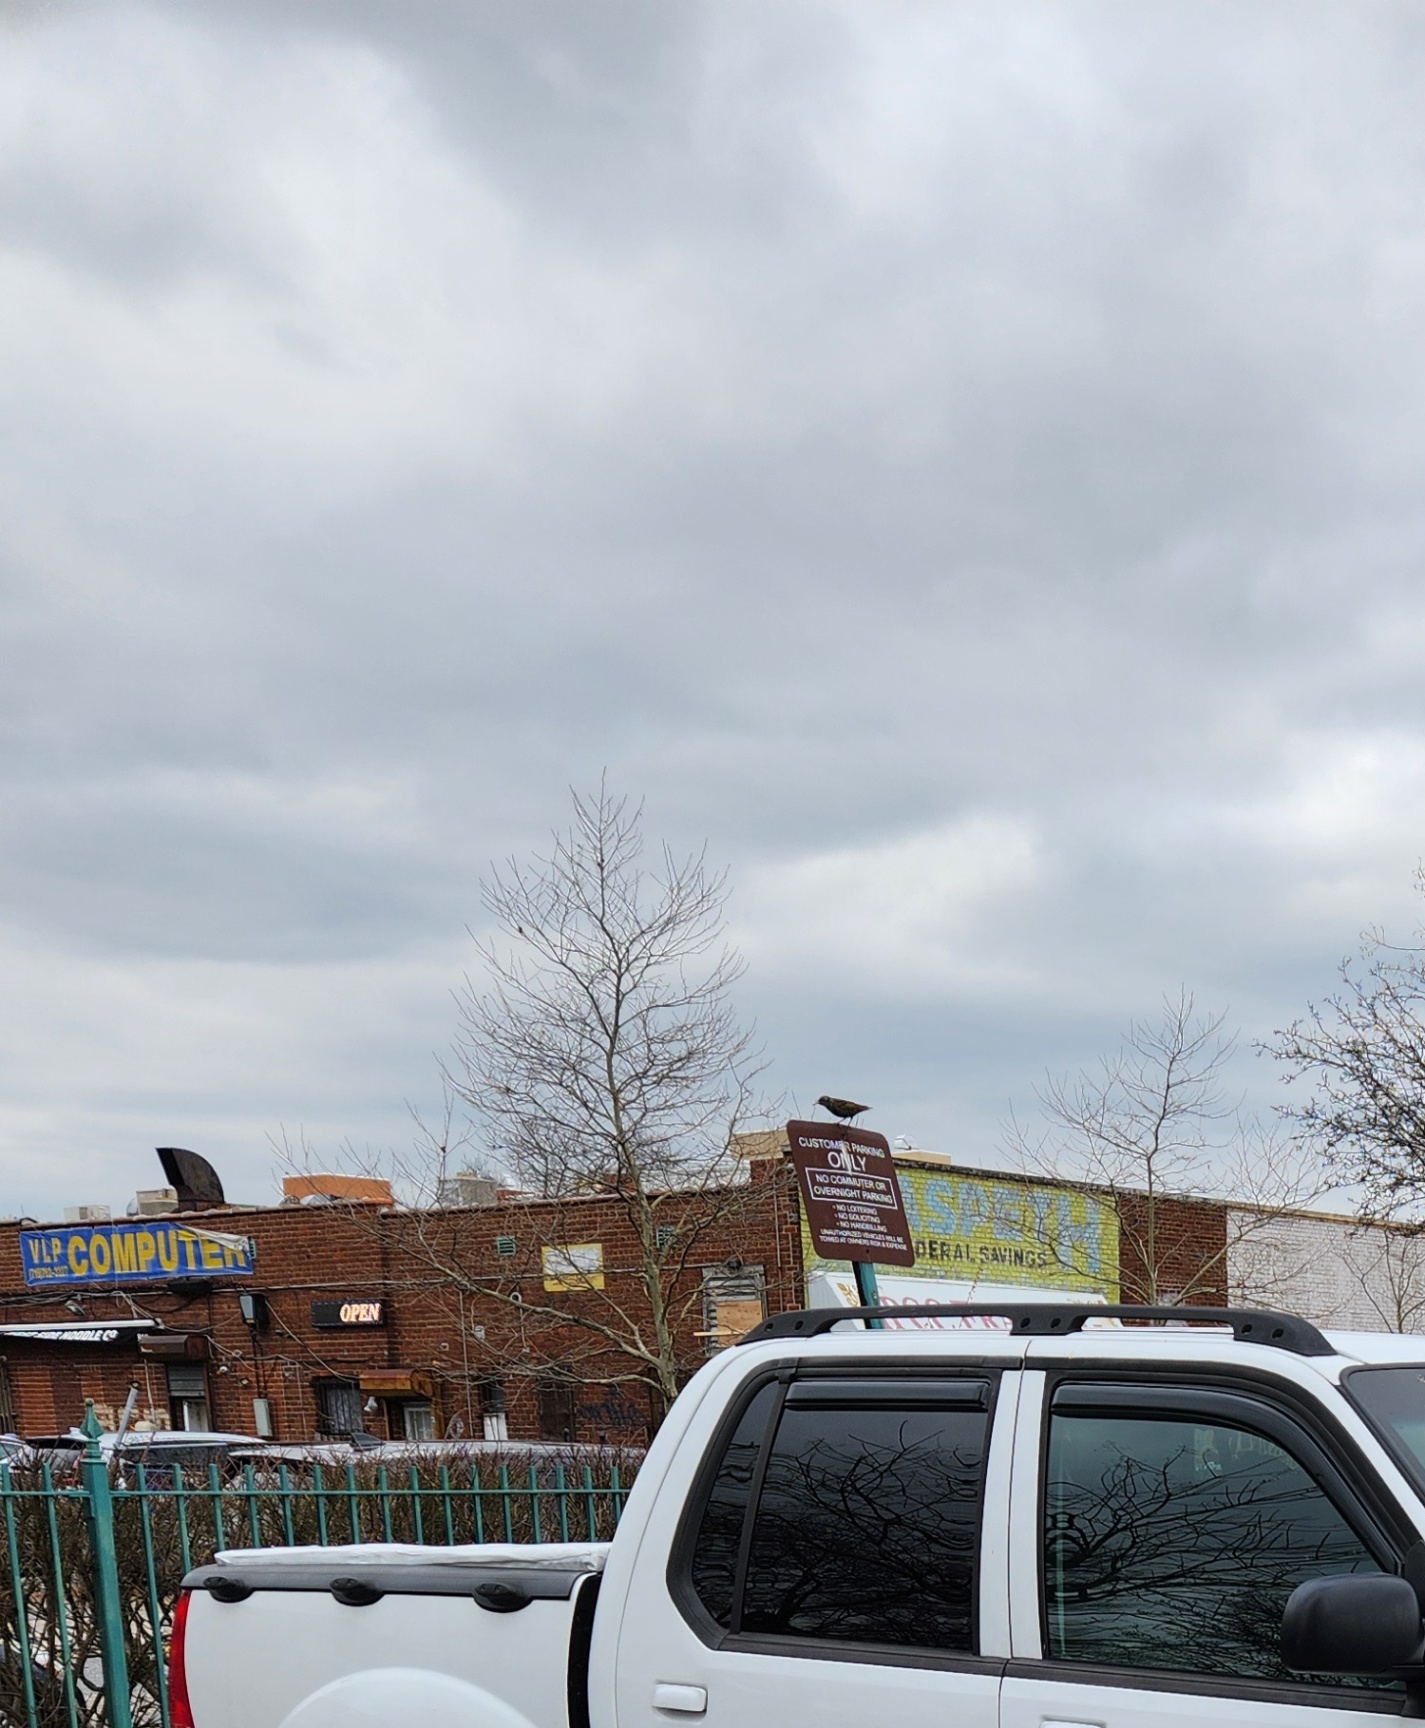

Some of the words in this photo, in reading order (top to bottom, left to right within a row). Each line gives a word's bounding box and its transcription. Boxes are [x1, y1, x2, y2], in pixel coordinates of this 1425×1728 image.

[798, 1136, 850, 1152] CUSTOMER
[851, 1143, 885, 1158] PARKING
[827, 1151, 866, 1172] ONLY
[815, 1173, 829, 1183] NO
[830, 1175, 875, 1189] COMMUTER
[875, 1181, 887, 1191] OR
[814, 1186, 861, 1199] OVERNIGHT
[862, 1190, 893, 1204] PARKING
[838, 1212, 848, 1220] NO
[846, 1205, 878, 1216] LOITERING
[67, 1230, 247, 1277] COMPUTER
[979, 1245, 1048, 1268] SAVINGS
[340, 1302, 381, 1323] OPEN
[59, 1330, 103, 1341] NOODLE
